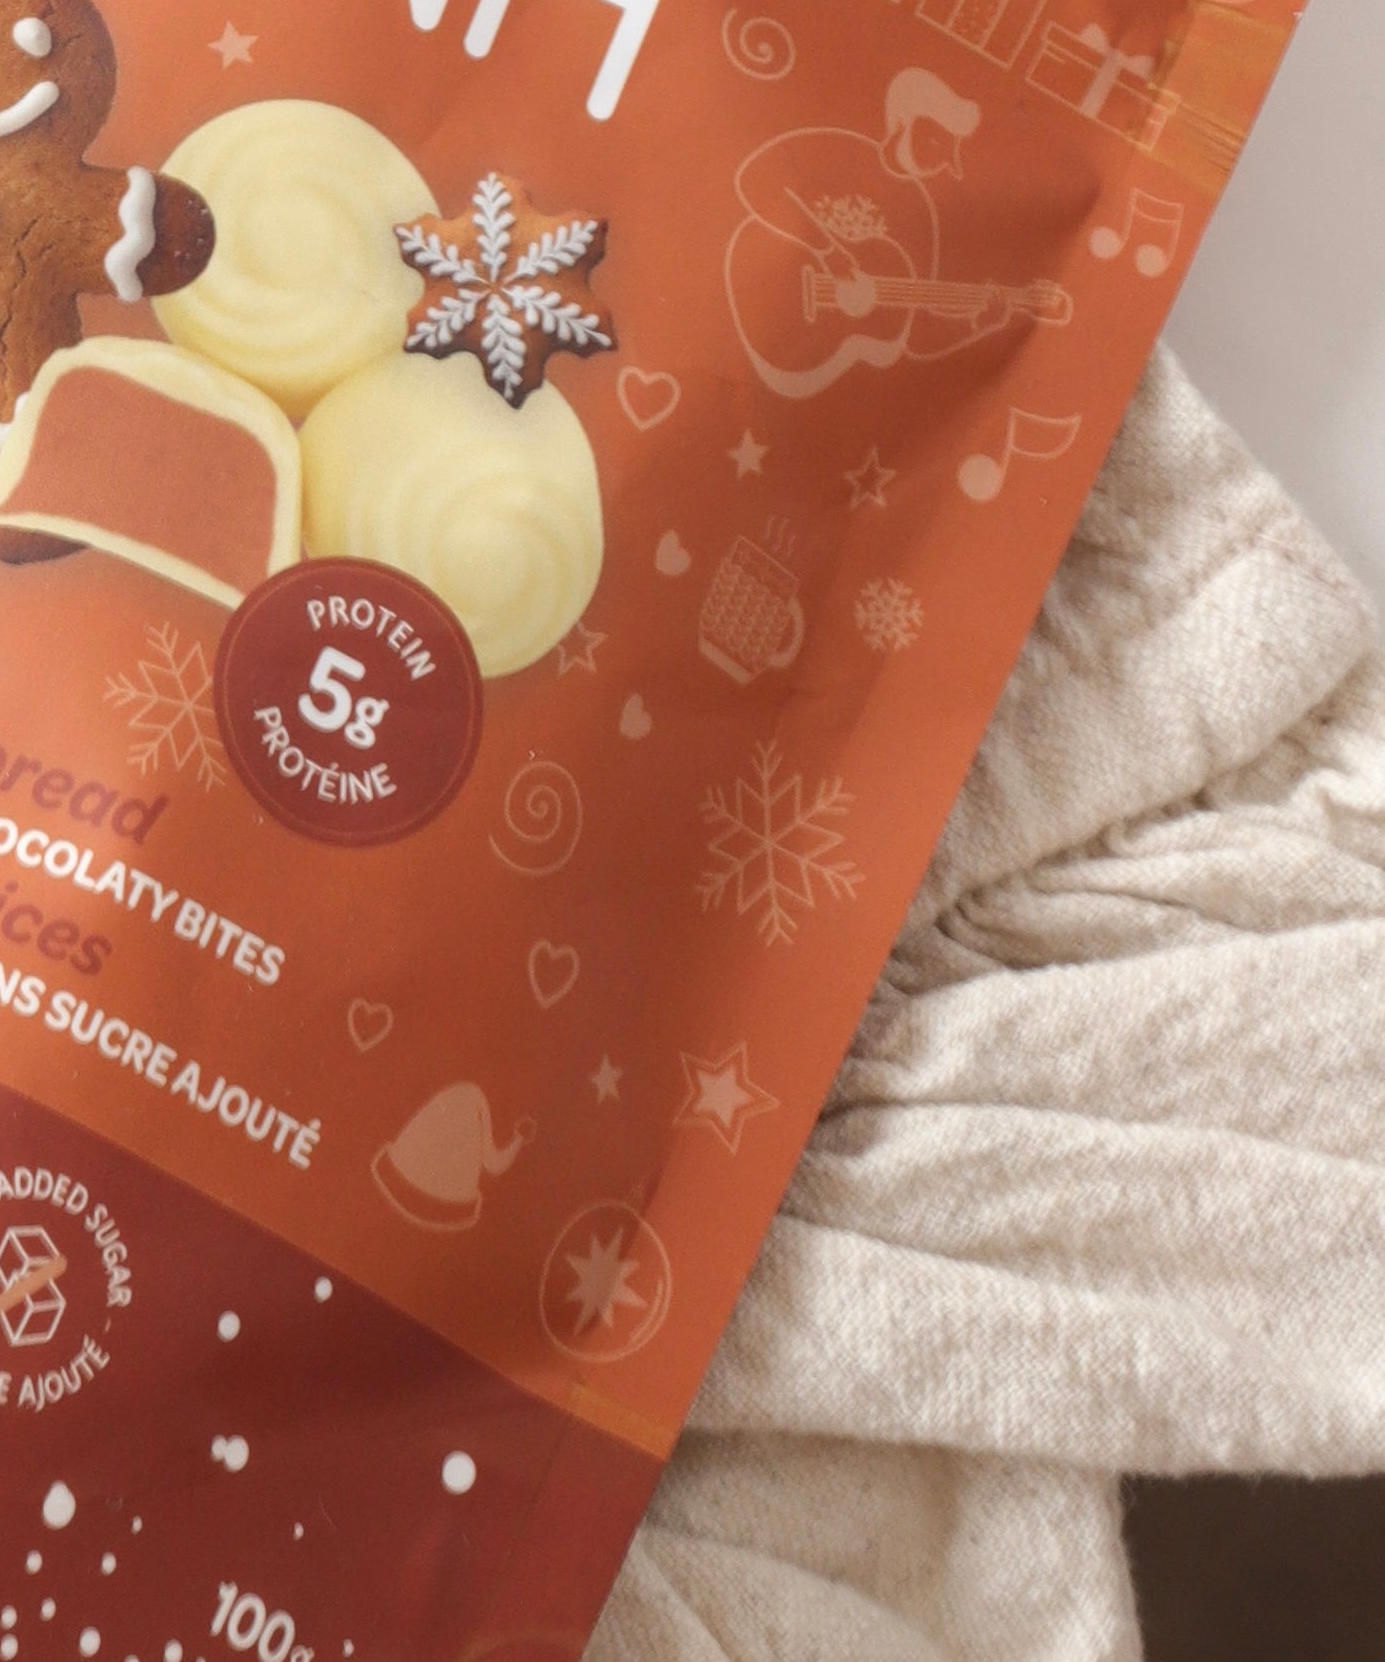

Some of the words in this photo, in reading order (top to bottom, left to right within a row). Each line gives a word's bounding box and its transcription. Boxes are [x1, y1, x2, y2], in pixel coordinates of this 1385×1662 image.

[306, 595, 436, 682] PROTEIN
[297, 644, 390, 750] 5g
[254, 703, 397, 806] PROTÉINE
[175, 899, 288, 988] BITES
[40, 988, 178, 1091] SUCRE
[169, 1061, 324, 1170] AJOUTÉ
[84, 1200, 132, 1310] SUGAR
[17, 1331, 112, 1411] AJOUTÉ
